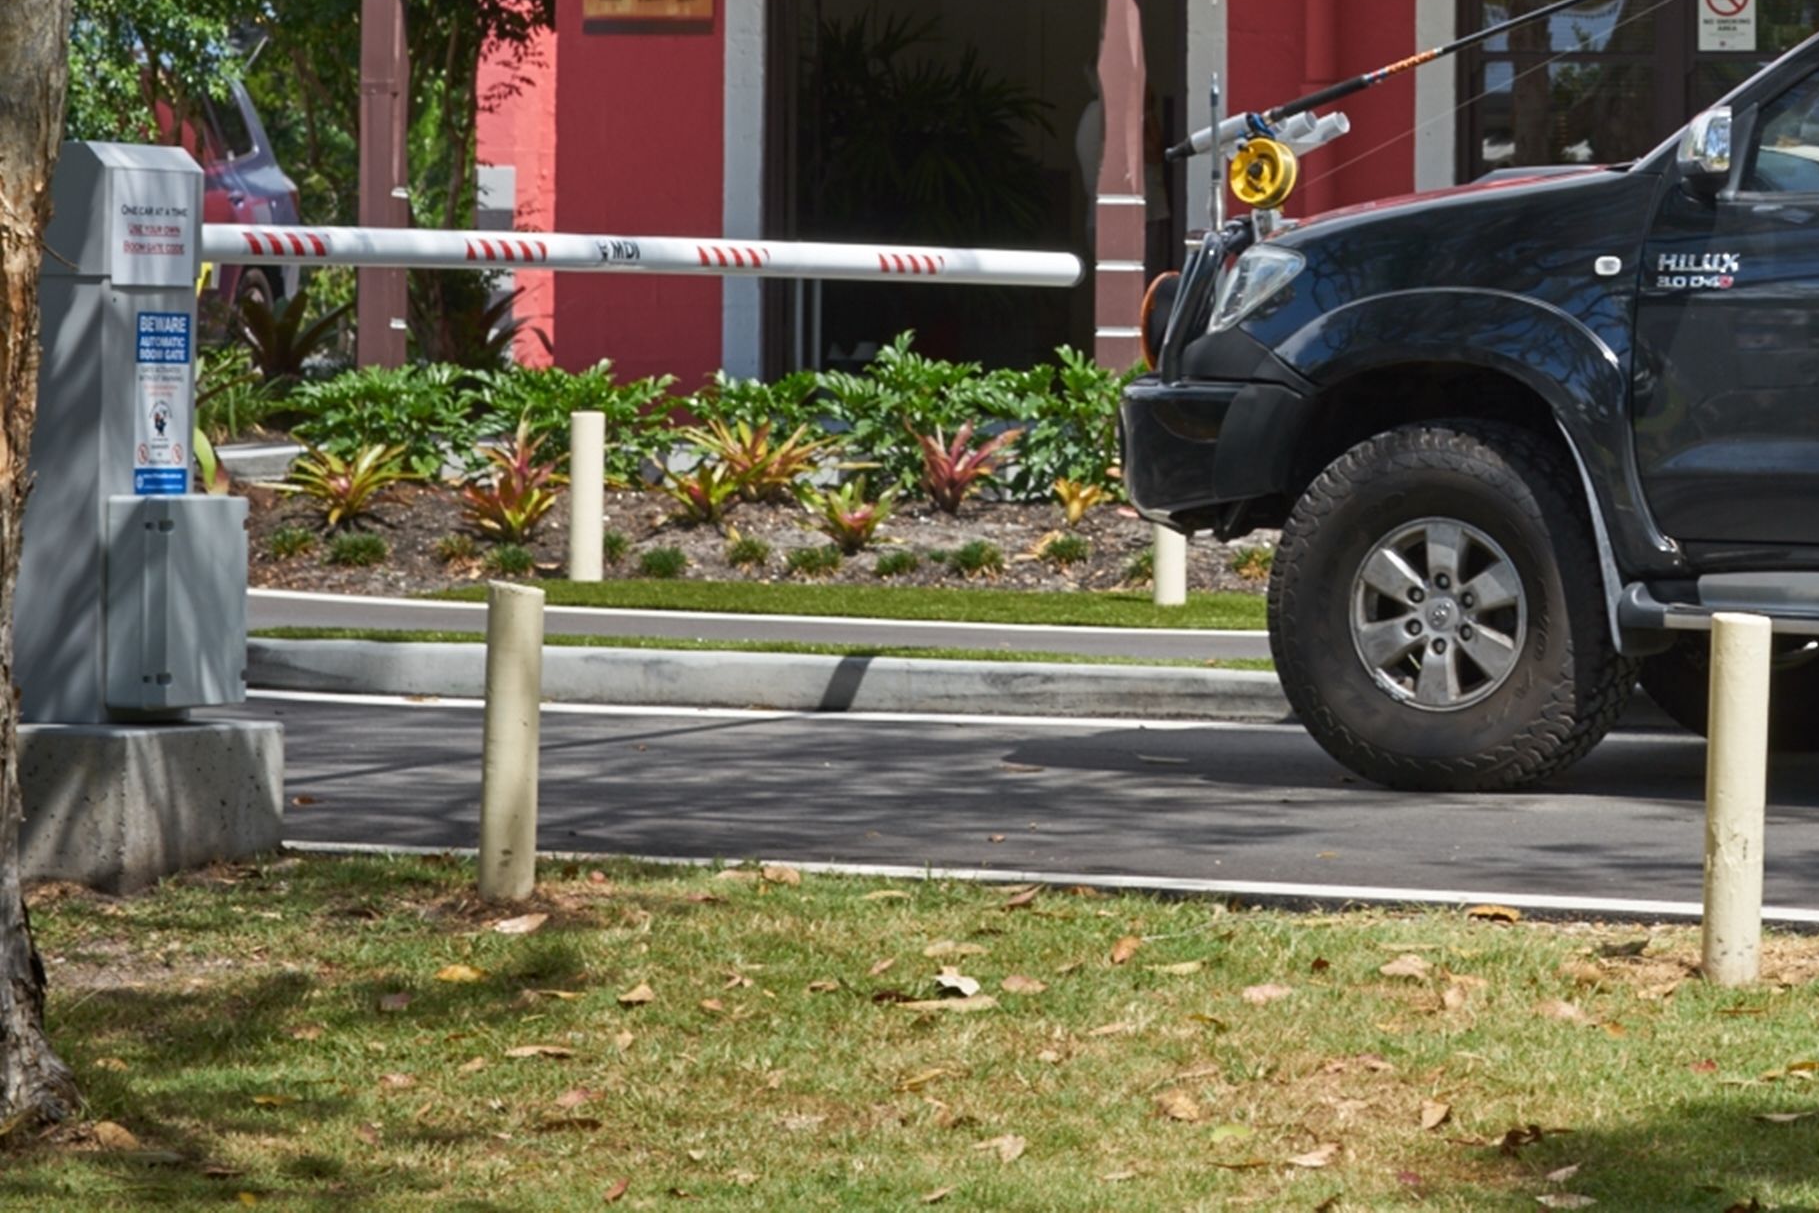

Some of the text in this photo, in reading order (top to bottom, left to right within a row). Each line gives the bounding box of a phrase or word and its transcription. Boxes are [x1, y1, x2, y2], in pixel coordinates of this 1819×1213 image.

[611, 240, 641, 259] MDI
[1658, 253, 1740, 273] HILUX
[139, 316, 187, 333] BEWARE
[139, 336, 185, 348] AUTOMATIC
[139, 348, 186, 361] BOOM GATE
